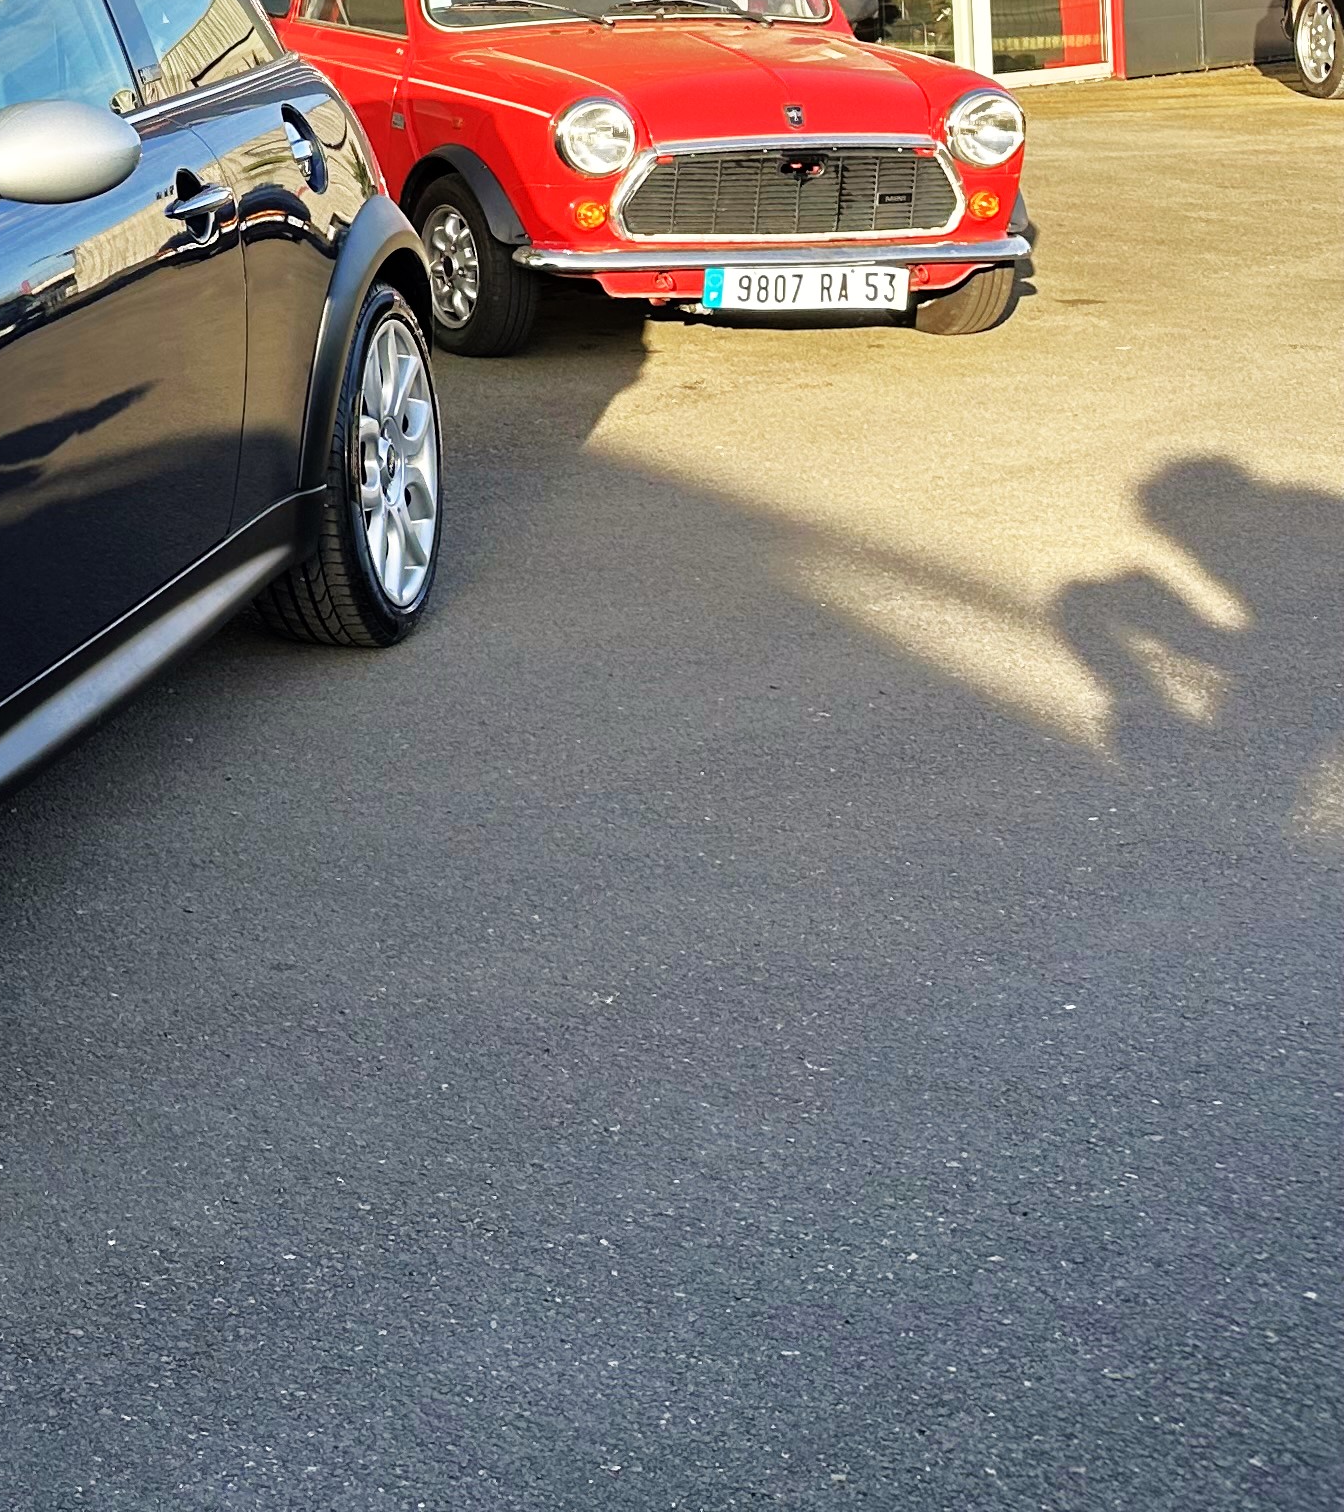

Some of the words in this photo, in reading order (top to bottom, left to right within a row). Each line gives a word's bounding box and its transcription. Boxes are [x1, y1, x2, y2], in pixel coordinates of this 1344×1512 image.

[737, 274, 804, 303] 9807
[820, 273, 849, 303] RA
[865, 272, 896, 303] 53
